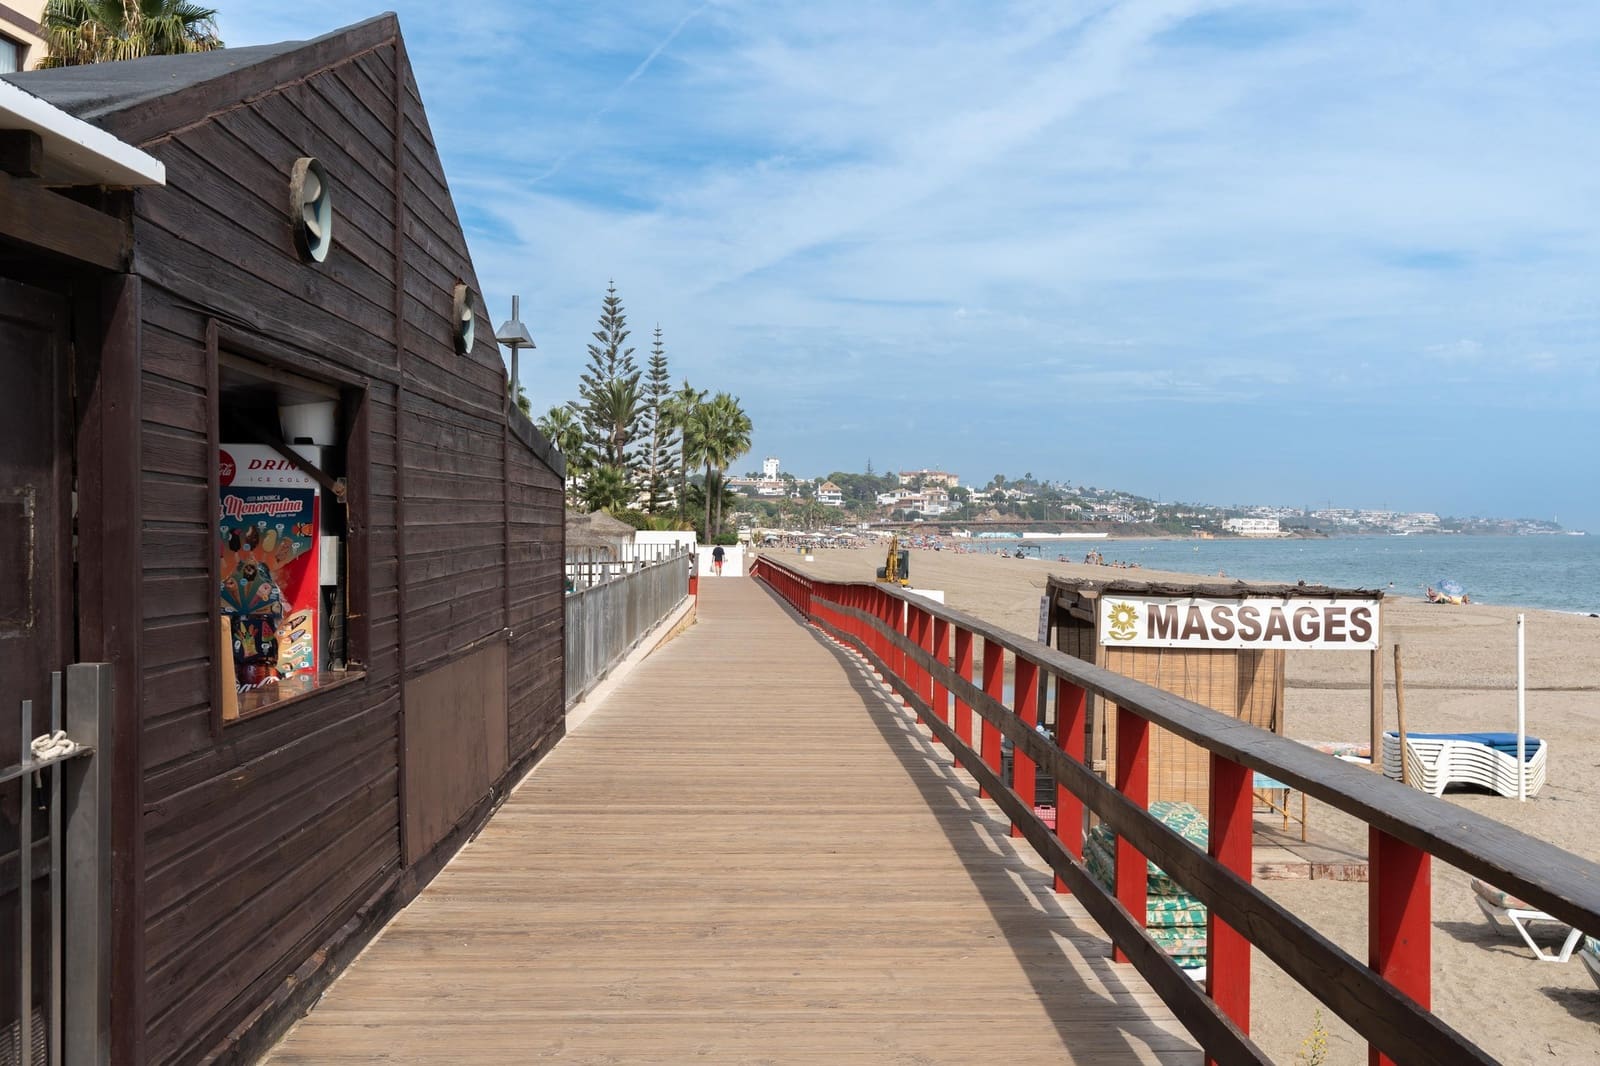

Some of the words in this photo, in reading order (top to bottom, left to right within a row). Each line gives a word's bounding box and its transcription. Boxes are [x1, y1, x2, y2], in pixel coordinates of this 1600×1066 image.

[248, 459, 313, 470] DRIN
[225, 495, 303, 521] Menorquina
[1147, 604, 1372, 642] MASSAGES
